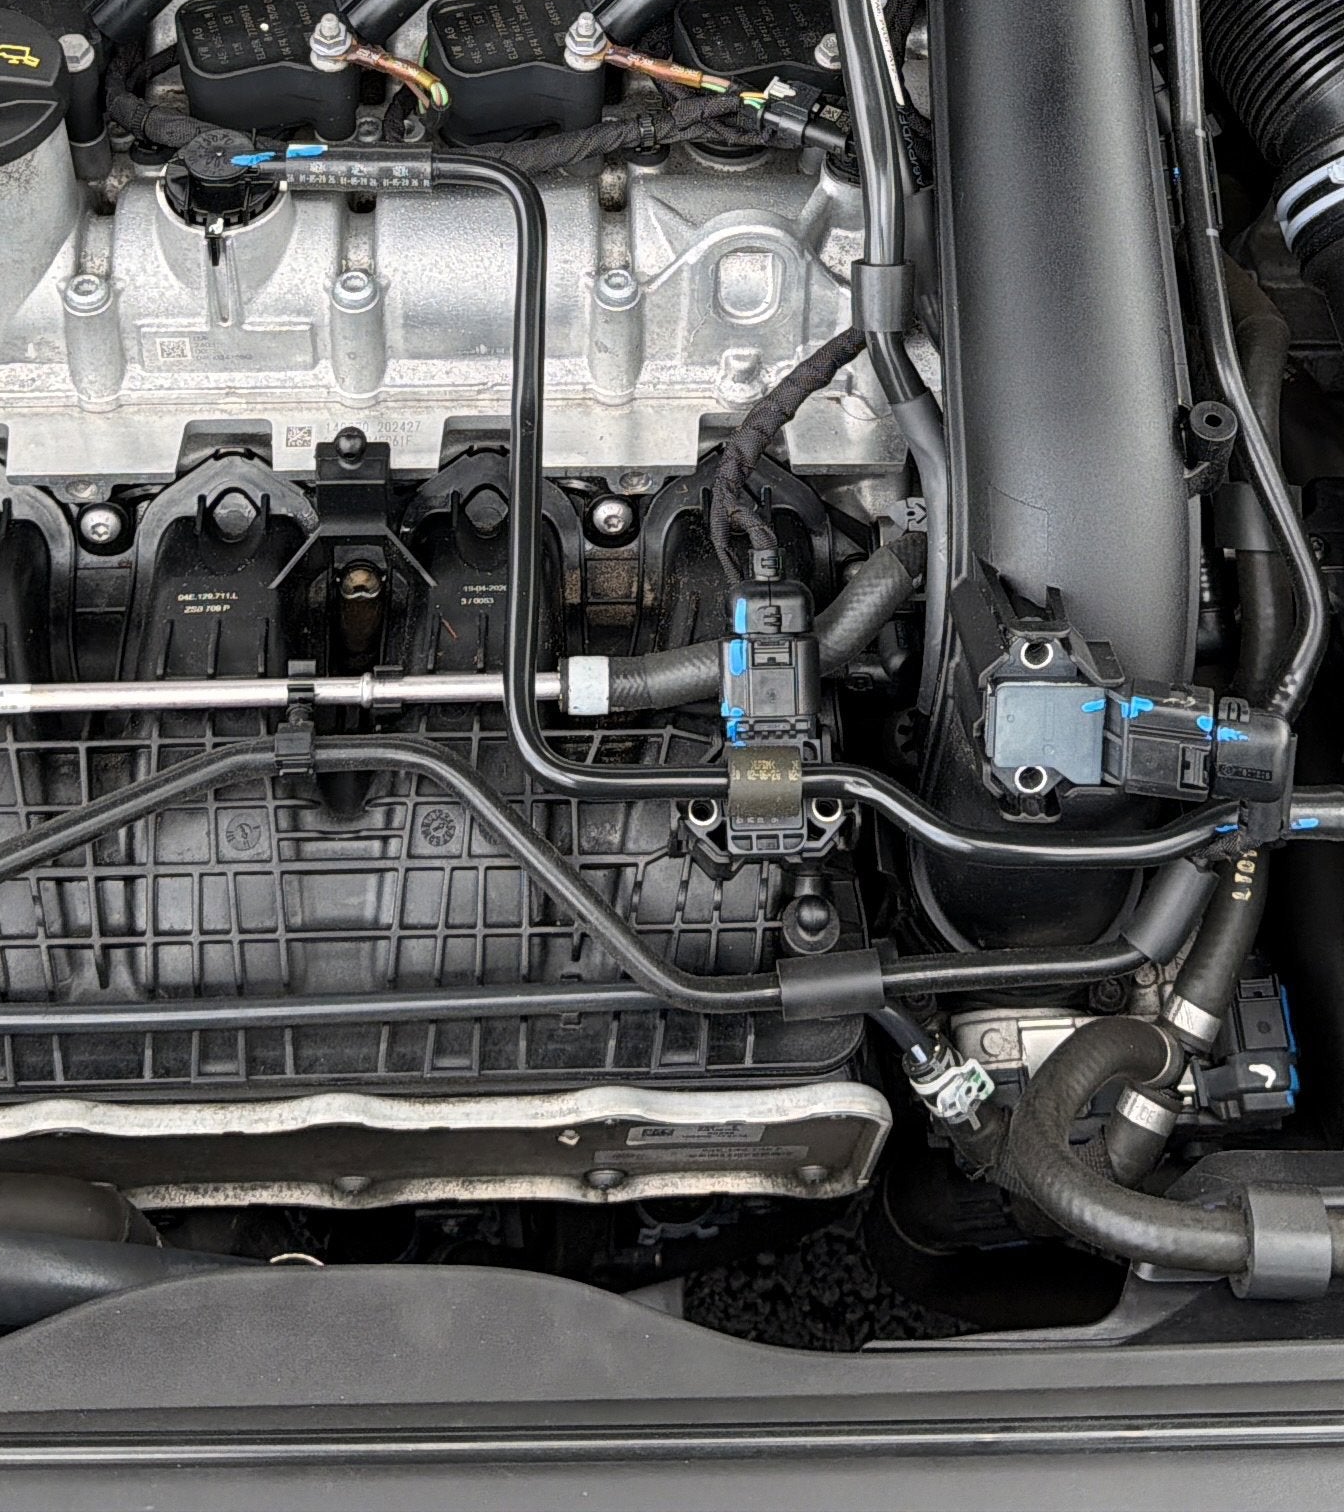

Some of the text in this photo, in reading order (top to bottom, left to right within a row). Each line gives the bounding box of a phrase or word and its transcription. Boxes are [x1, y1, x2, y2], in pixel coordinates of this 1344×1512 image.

[192, 27, 210, 60] VW AG
[444, 26, 464, 58] VW AG
